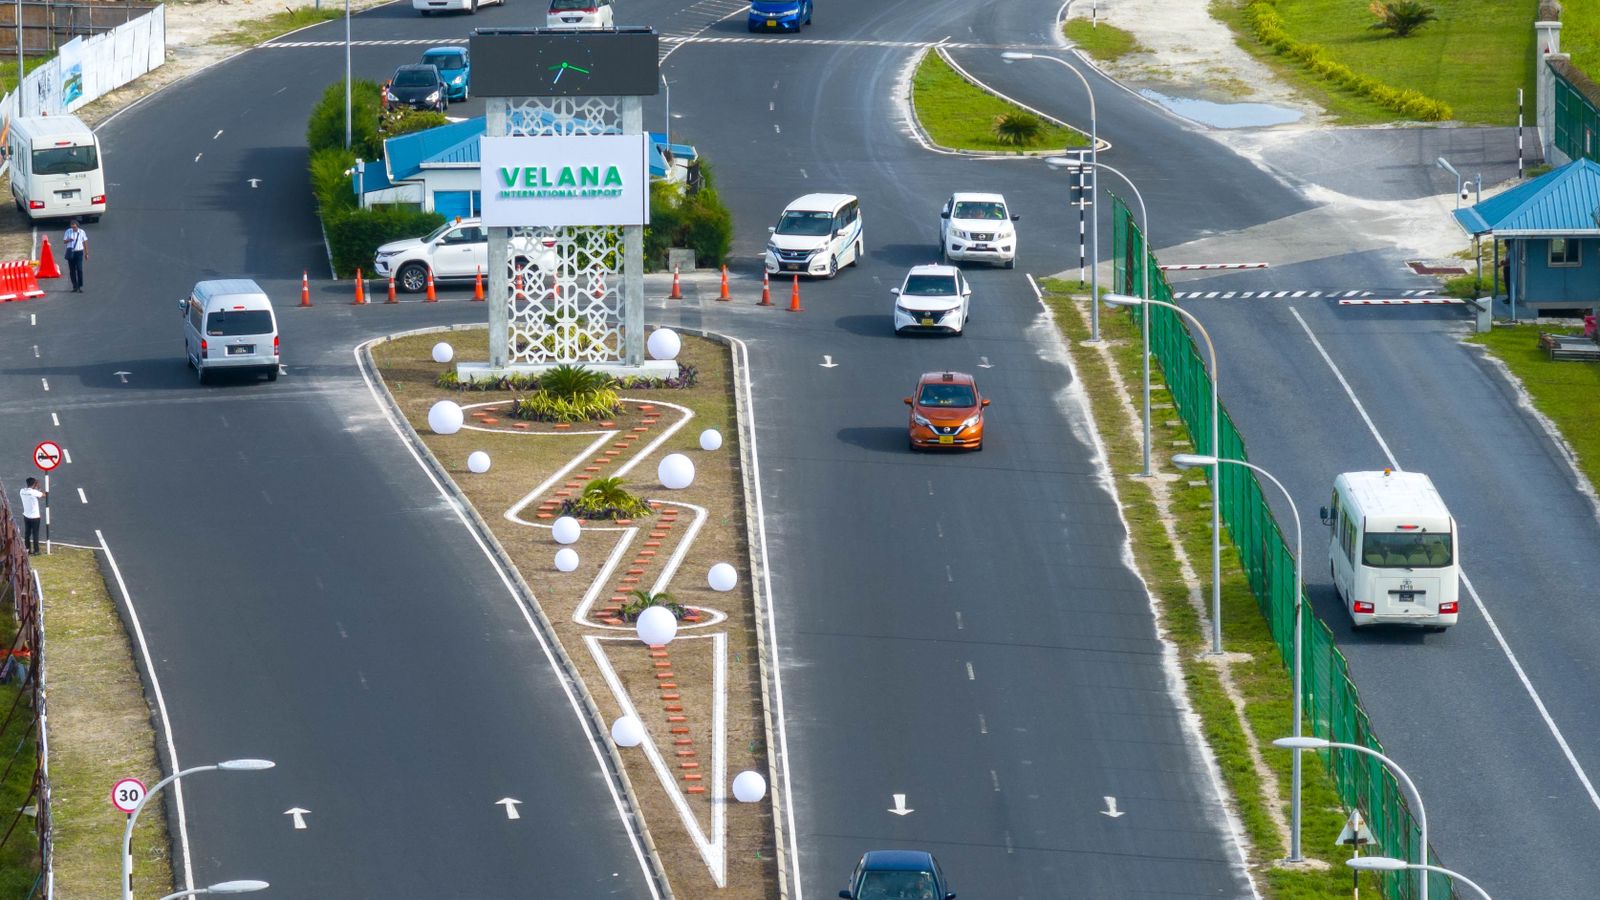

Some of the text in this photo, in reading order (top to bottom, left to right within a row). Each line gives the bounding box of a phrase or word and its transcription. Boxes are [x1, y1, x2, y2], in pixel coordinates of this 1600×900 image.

[500, 166, 623, 187] VELANA
[499, 188, 624, 199] INTERNATIONAL AIRPORT
[119, 789, 139, 801] 30
